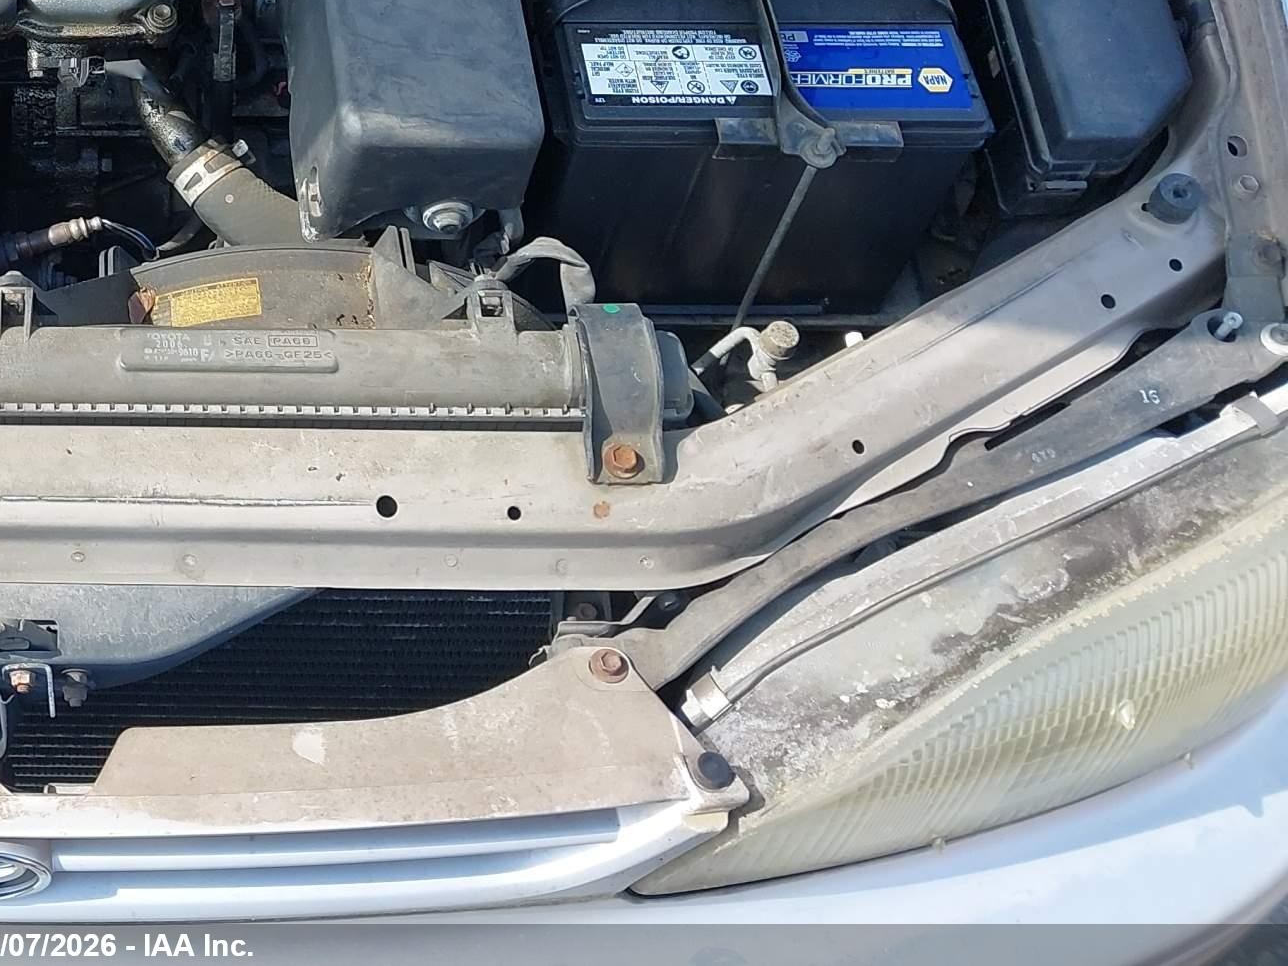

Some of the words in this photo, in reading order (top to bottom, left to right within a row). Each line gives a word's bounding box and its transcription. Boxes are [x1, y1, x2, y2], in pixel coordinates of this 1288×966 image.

[791, 74, 912, 85] PROFORMER
[923, 75, 948, 86] NAPA
[632, 96, 725, 104] DANGER/POISON
[232, 336, 263, 346] SAE
